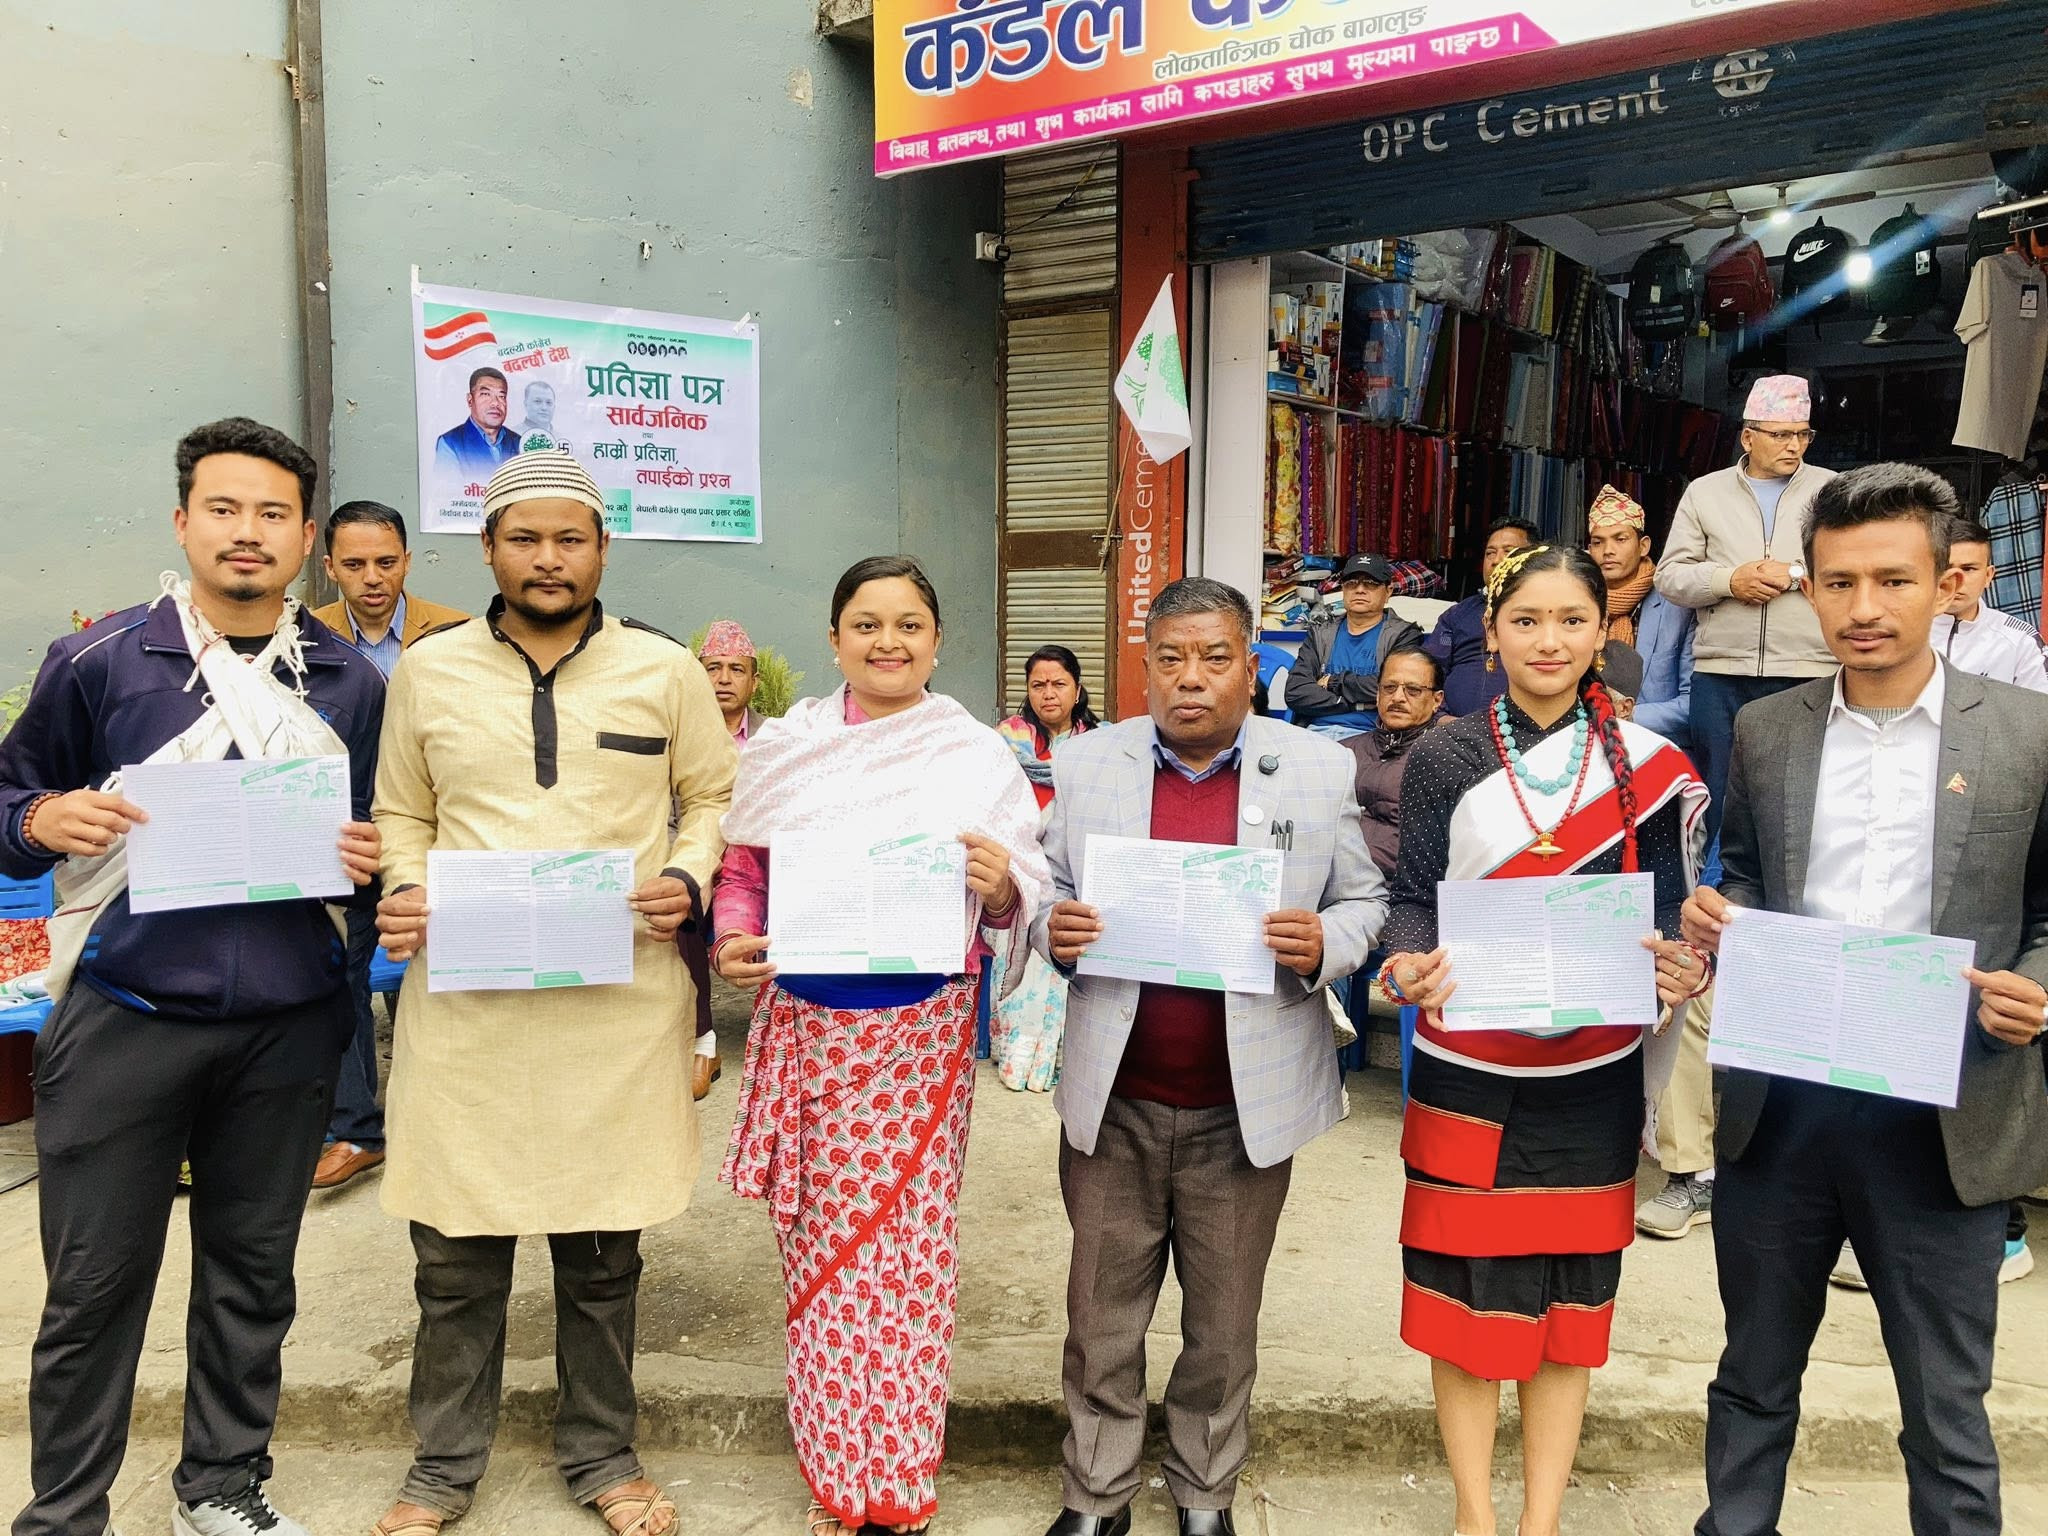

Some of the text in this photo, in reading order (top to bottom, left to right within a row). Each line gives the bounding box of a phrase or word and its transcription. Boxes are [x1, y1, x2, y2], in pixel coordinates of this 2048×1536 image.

[1289, 24, 1336, 50] चोक
[1342, 6, 1429, 39] बागलुङ
[889, 139, 930, 161] विवाह
[995, 120, 1026, 143] तथा
[1035, 112, 1063, 139] शुभ
[1073, 98, 1131, 127] कार्यका
[1140, 85, 1182, 114] लागि
[1194, 72, 1275, 104] कपडाहरु
[1285, 58, 1334, 91] सुपथ
[1346, 44, 1416, 80] मुल्यमा
[1429, 25, 1501, 58] पाइन्छ
[1362, 70, 1669, 163] OPC Cement
[1798, 239, 1824, 254] NIKE
[585, 361, 726, 406] प्रतिज्ञा पत्र
[606, 403, 709, 432] सार्वजनिक
[593, 438, 680, 465] हाम्रो प्रतिज्ञा,
[698, 471, 732, 490] प्रश्न
